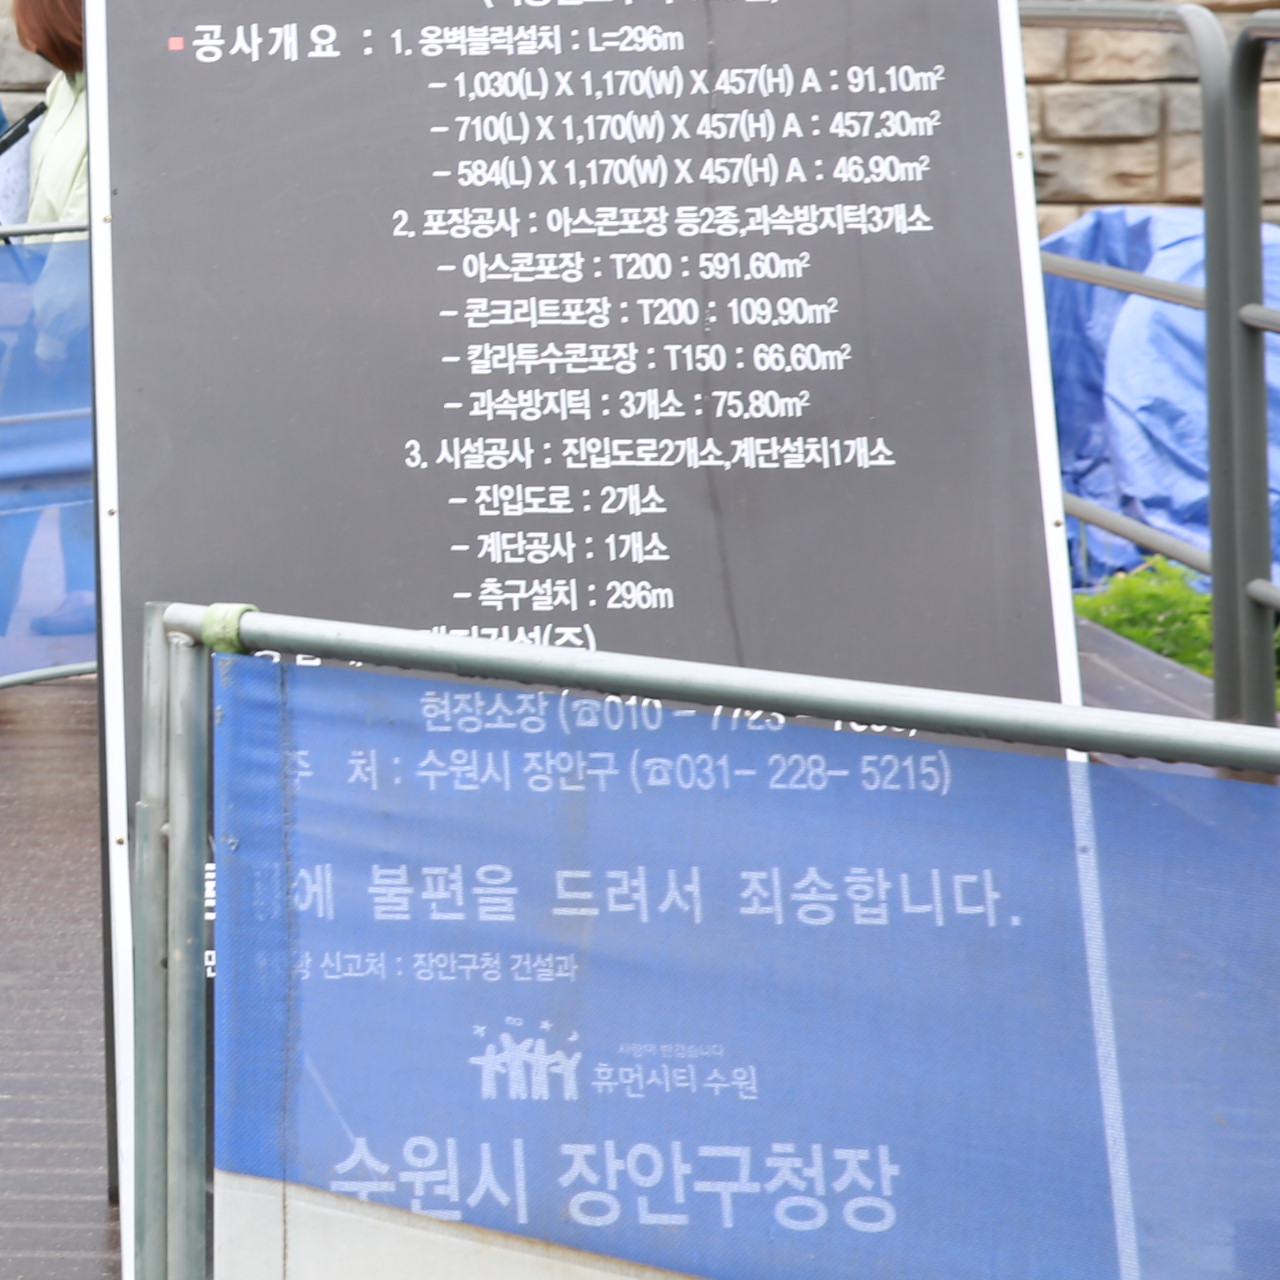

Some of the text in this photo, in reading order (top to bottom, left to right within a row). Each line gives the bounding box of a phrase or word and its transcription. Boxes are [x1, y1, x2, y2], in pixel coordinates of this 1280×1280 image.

[192, 22, 340, 62] 공사개요
[390, 28, 413, 57] 1.
[588, 25, 685, 52] L=296m
[454, 67, 549, 101] 1,030(L)
[581, 65, 684, 100] 1,170(W)
[716, 63, 794, 97] 457(H)
[800, 67, 822, 94] A
[454, 111, 530, 145] 710(L)
[561, 109, 665, 144] 1,170(W)
[696, 108, 776, 142] 457(H)
[781, 112, 804, 139] A
[457, 155, 533, 189] 584(L)
[564, 154, 668, 189] 1,170(W)
[699, 153, 779, 187] 457(H)
[785, 157, 808, 183] A
[392, 209, 416, 238] 2.
[422, 206, 520, 239] 포장공사
[546, 205, 669, 238] 아스콘포장
[462, 251, 585, 284] 아스콘포장
[609, 252, 672, 280] T200
[464, 296, 611, 329] 콘크리트포장
[636, 298, 699, 325] T200
[466, 342, 639, 375] 칼라투수콘포장
[663, 343, 727, 371] T150
[468, 388, 591, 421] 과속방지턱
[619, 388, 685, 421] 3개소
[404, 439, 428, 469] 3.
[435, 437, 535, 470] 시설공사
[475, 483, 574, 516] 진입도로
[600, 483, 667, 516] 2개소
[477, 530, 576, 564] 계단공사
[605, 530, 670, 564] 1개소
[478, 577, 578, 611] 측구설치
[606, 580, 674, 610] 296m
[420, 691, 547, 733] 현장소장
[416, 748, 511, 791] 수원시
[523, 748, 620, 792] 장안구
[860, 749, 951, 796] 5215)
[368, 863, 520, 922] 불편을
[551, 865, 703, 923] 드려서
[739, 865, 1022, 928] 죄송합니다.
[320, 951, 386, 980] 신고처
[413, 951, 502, 983] 장안구청
[510, 951, 579, 983] 건설과
[592, 1063, 758, 1100] 휴먼시티 수원
[330, 1136, 900, 1232] 수원시 장안구청장
